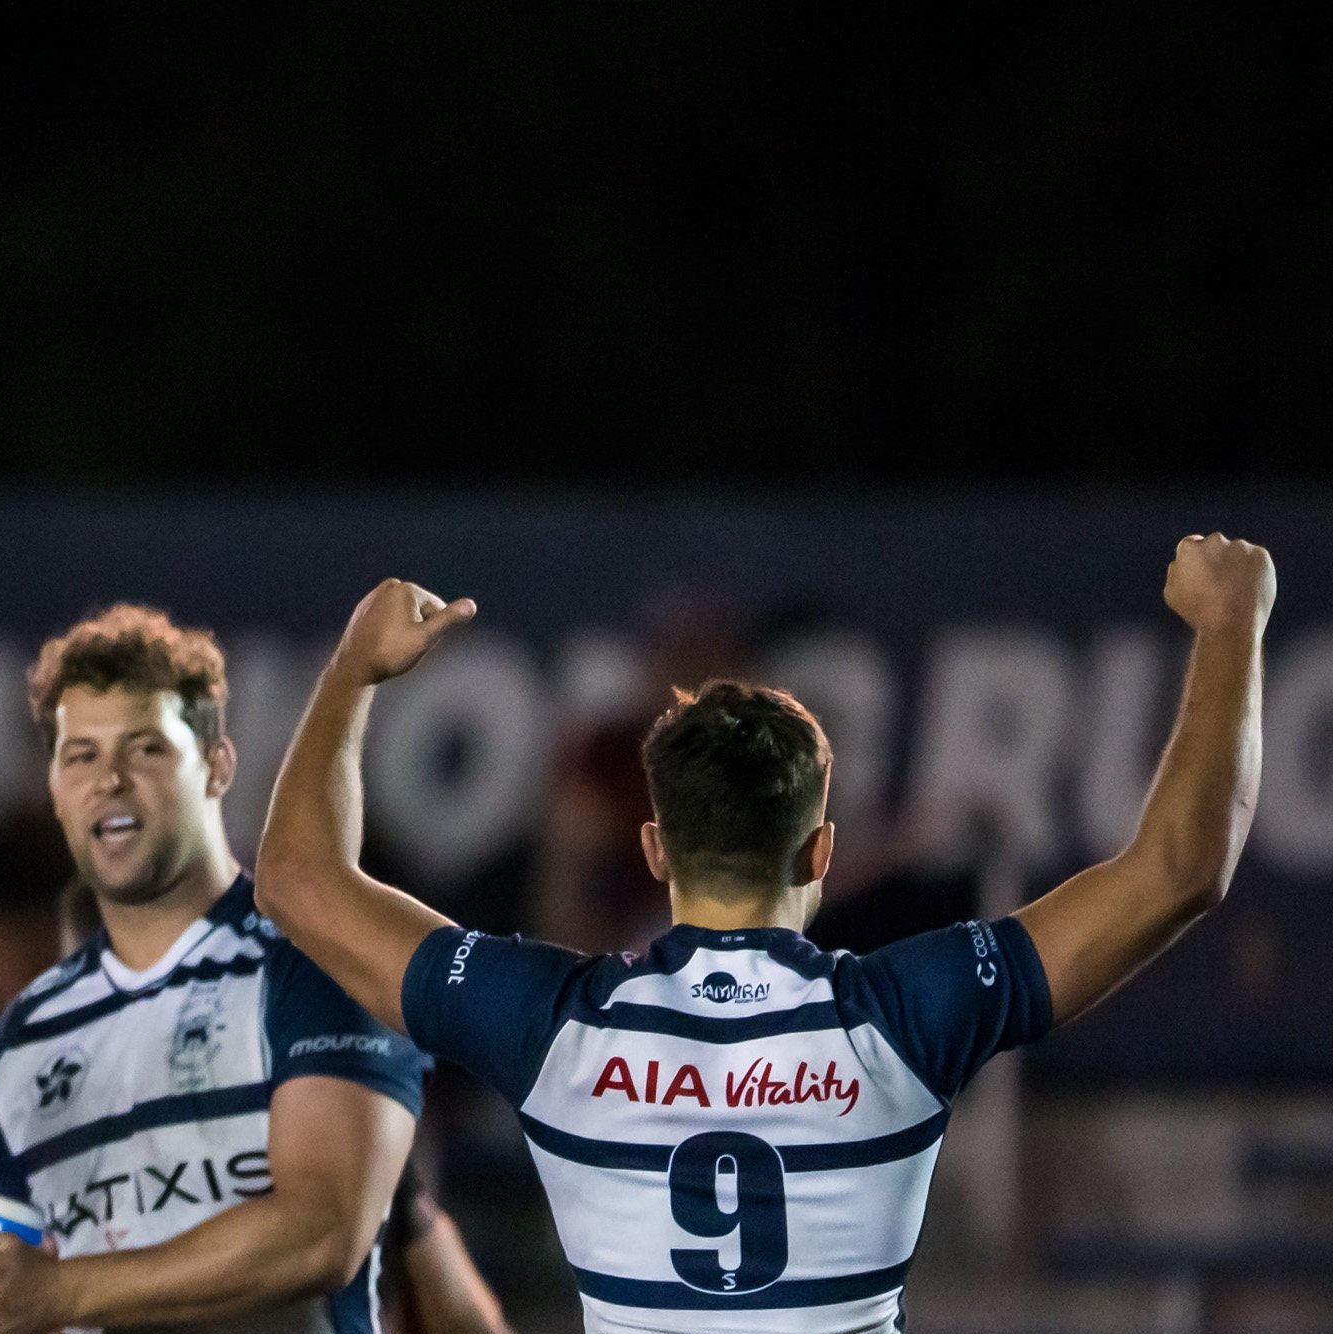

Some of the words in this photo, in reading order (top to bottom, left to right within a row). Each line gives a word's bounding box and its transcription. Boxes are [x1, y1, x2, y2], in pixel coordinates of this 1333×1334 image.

[591, 1056, 712, 1108] AIA
[725, 1056, 860, 1118] Vitality
[668, 1130, 789, 1296] 9
